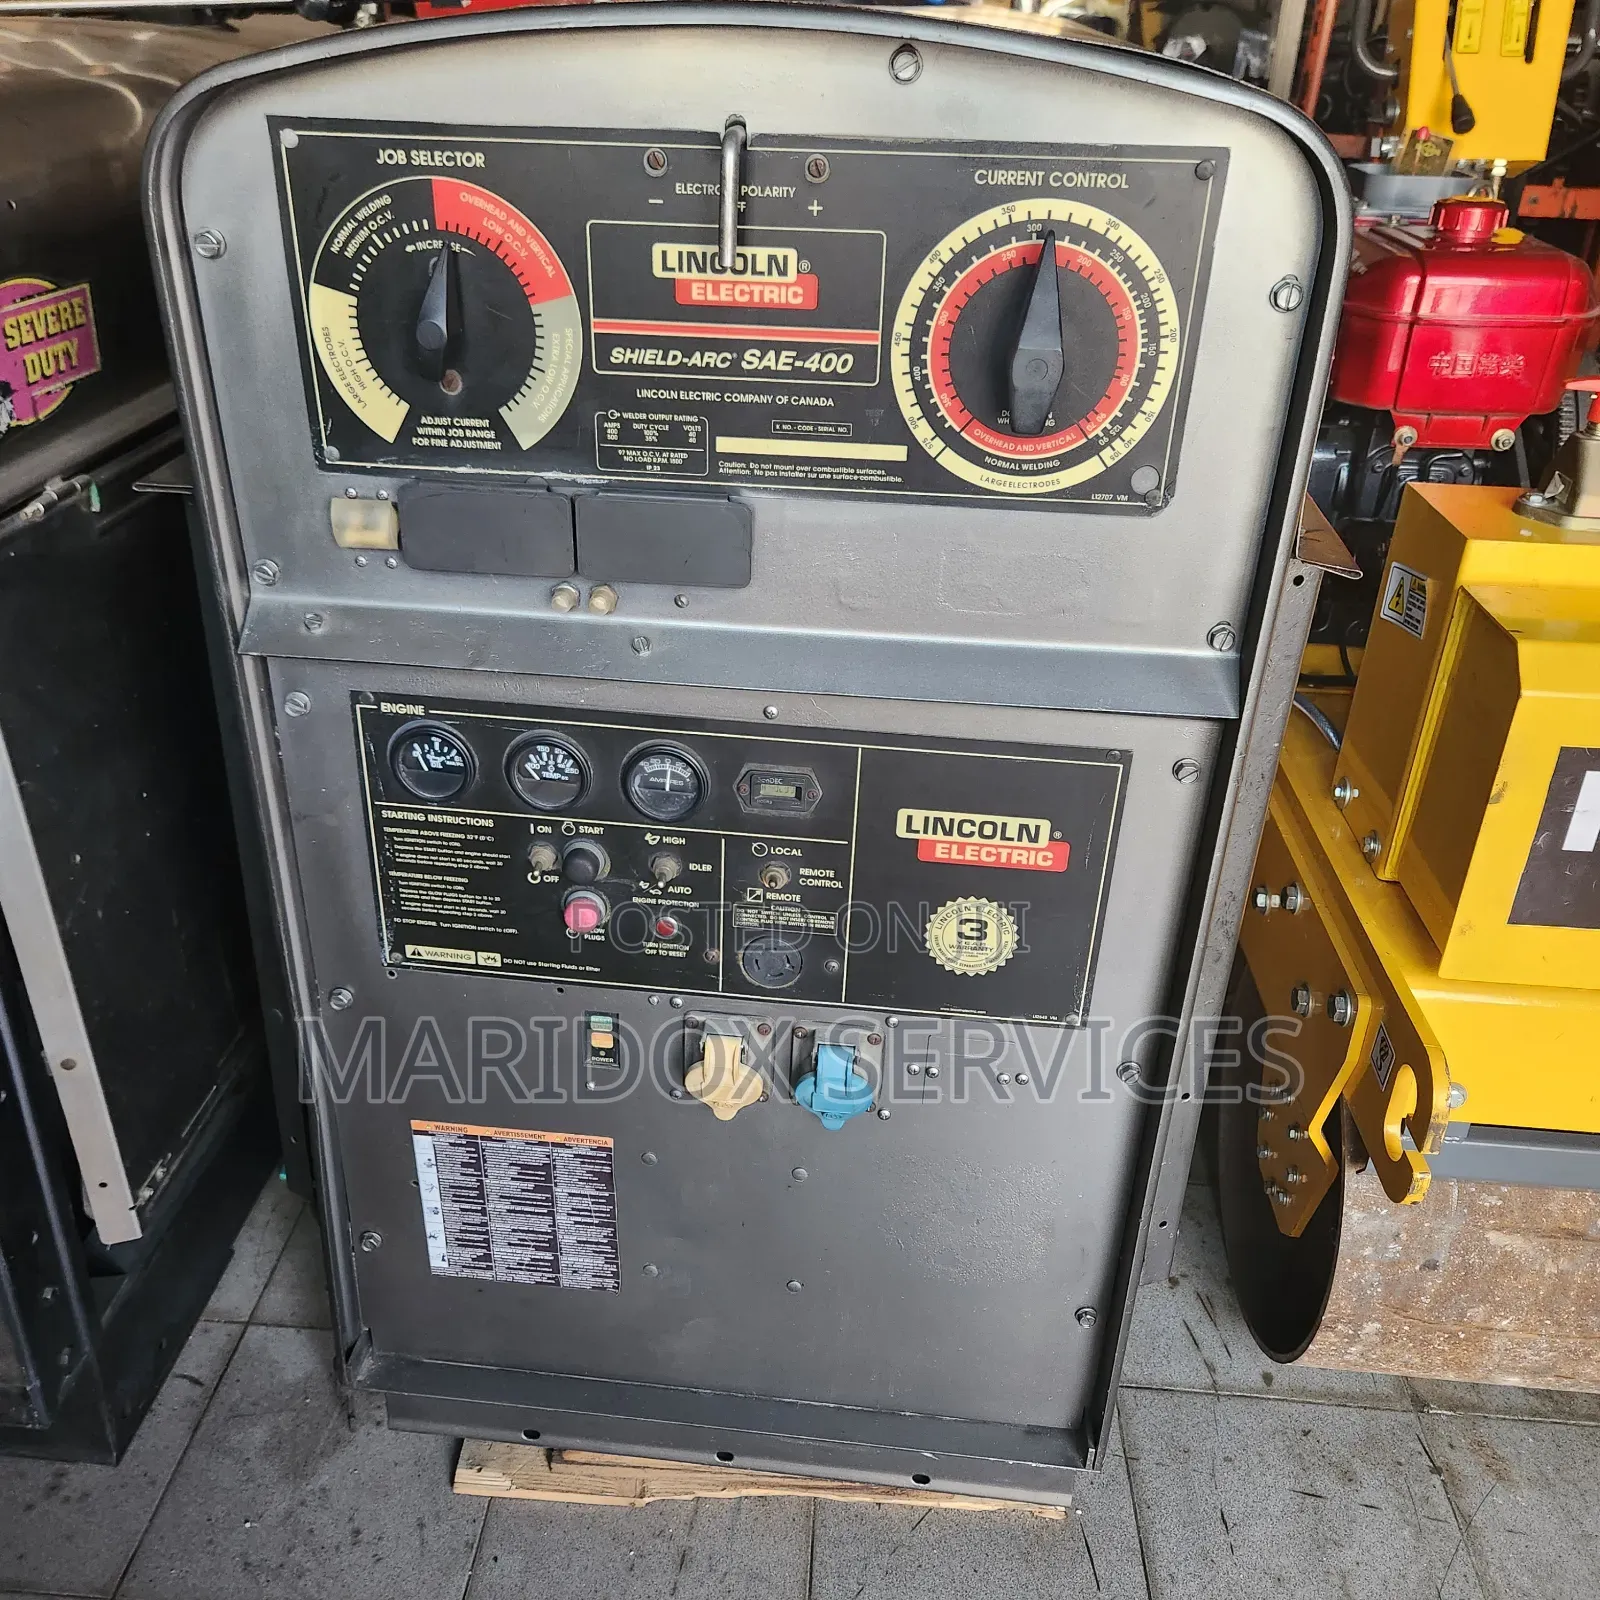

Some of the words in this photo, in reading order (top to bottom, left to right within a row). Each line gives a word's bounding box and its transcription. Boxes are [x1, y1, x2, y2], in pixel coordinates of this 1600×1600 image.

[376, 148, 407, 165] JOB
[410, 150, 485, 168] SELECTOR
[974, 169, 1044, 186] CURRENT
[1049, 171, 1130, 189] CONTROL
[740, 185, 796, 198] POLARITY
[1001, 204, 1016, 215] 350
[329, 218, 359, 254] NORMAL
[354, 194, 392, 221] WELDING
[1026, 222, 1043, 233] 300
[1105, 217, 1120, 231] 300
[343, 226, 371, 259] MEDIUM
[368, 209, 396, 231] O.C.V.
[459, 191, 508, 221] OVERHEAD
[507, 219, 527, 237] AND
[525, 235, 556, 279] VERTICAL
[482, 216, 505, 235] LOW
[503, 233, 529, 260] O.C.V.
[415, 239, 461, 253] INCRESE
[928, 249, 942, 264] 400
[1001, 249, 1017, 262] 250
[1077, 255, 1093, 268] 200
[1109, 248, 1125, 264] 250
[661, 249, 789, 278] LINCOLN
[1153, 268, 1166, 284] 250
[932, 276, 946, 293] 350
[691, 282, 804, 304] ELECTRIC
[1139, 292, 1152, 309] 200
[939, 310, 950, 327] 300
[1121, 306, 1133, 322] 150
[3, 296, 87, 350] SEVERE
[894, 331, 902, 348] 450
[1169, 327, 1177, 344] 200
[321, 326, 348, 381] ELECTRODES
[551, 331, 560, 362] EXTRA
[1148, 342, 1157, 357] 150
[24, 337, 79, 385] DUTY
[741, 349, 854, 374] SAE-400
[350, 368, 368, 390] HIGH
[545, 363, 558, 386] LOW
[912, 366, 921, 382] 400
[1119, 374, 1131, 387] 100
[344, 381, 368, 409] LARGE
[538, 366, 570, 423] APPLICATIONS
[636, 388, 678, 400] LINCOLN
[679, 389, 721, 402] ELECTRIC
[723, 391, 775, 404] COMPANY
[776, 394, 789, 405] OF
[790, 395, 834, 407] CANADA
[420, 415, 451, 426] ADJUST
[453, 417, 490, 428] CURRENT
[622, 412, 647, 420] WELDER
[648, 413, 673, 421] OUTPUT
[673, 414, 699, 422] RATING
[907, 416, 919, 430] 500
[1096, 412, 1107, 423] 90
[1144, 410, 1156, 423] 150
[416, 427, 446, 437] WITHIN
[447, 428, 465, 438] JOB
[465, 429, 496, 439] RANGE
[1086, 422, 1097, 432] 70
[1110, 424, 1123, 437] 125
[412, 436, 430, 446] FOR
[430, 438, 449, 448] FINE
[450, 439, 502, 450] ADJUSTMENT
[921, 437, 934, 450] 575
[973, 428, 1015, 451] OVERHEAD
[1016, 443, 1035, 452] AND
[1035, 432, 1077, 451] VERTICAL
[1098, 436, 1109, 446] 90
[1123, 437, 1136, 449] 140
[984, 455, 1020, 471] NORMAL
[1021, 459, 1061, 471] WELDING
[1109, 450, 1122, 462] 105
[718, 460, 748, 469] Caution:
[749, 462, 759, 470] Do
[760, 463, 772, 471] not
[812, 465, 855, 474] combustible
[856, 467, 887, 476] surfaces.
[718, 468, 751, 476] Attention:
[764, 470, 778, 478] pas
[860, 474, 904, 483] combustible.
[380, 701, 426, 716] ENGINE
[541, 771, 562, 779] TEMP
[381, 810, 426, 822] STARTING
[427, 813, 495, 828] INSTRUCTIONS
[537, 825, 552, 834] ON
[578, 825, 605, 835] START
[905, 814, 1041, 844] LINCOLN
[662, 836, 686, 845] HIGH
[770, 846, 803, 857] LOCAL
[935, 842, 1053, 866] ELECTRIC
[689, 863, 713, 872] IDLER
[799, 867, 835, 878] REMOTE
[543, 875, 560, 883] OFF
[799, 878, 843, 889] CONTROL
[667, 886, 692, 895] AUTO
[766, 892, 801, 903] REMOTE
[632, 896, 657, 905] ENGINE
[658, 898, 700, 908] PROTECTION
[770, 904, 801, 912] CAUTION
[935, 905, 972, 930] LINCOLN
[976, 905, 1011, 936] ELECTRIC
[957, 918, 988, 941] 3
[584, 934, 606, 942] PLUGS
[642, 941, 658, 949] TURN
[659, 943, 690, 951] IGNITION
[948, 943, 995, 953] WARRANTY
[424, 949, 472, 961] WARNING
[669, 950, 687, 958] RESET
[538, 961, 561, 969] Starting
[434, 1124, 468, 1134] WARNING
[493, 1129, 546, 1140] AVERTISSEMENT
[563, 1136, 609, 1146] ADVERTENCIA
